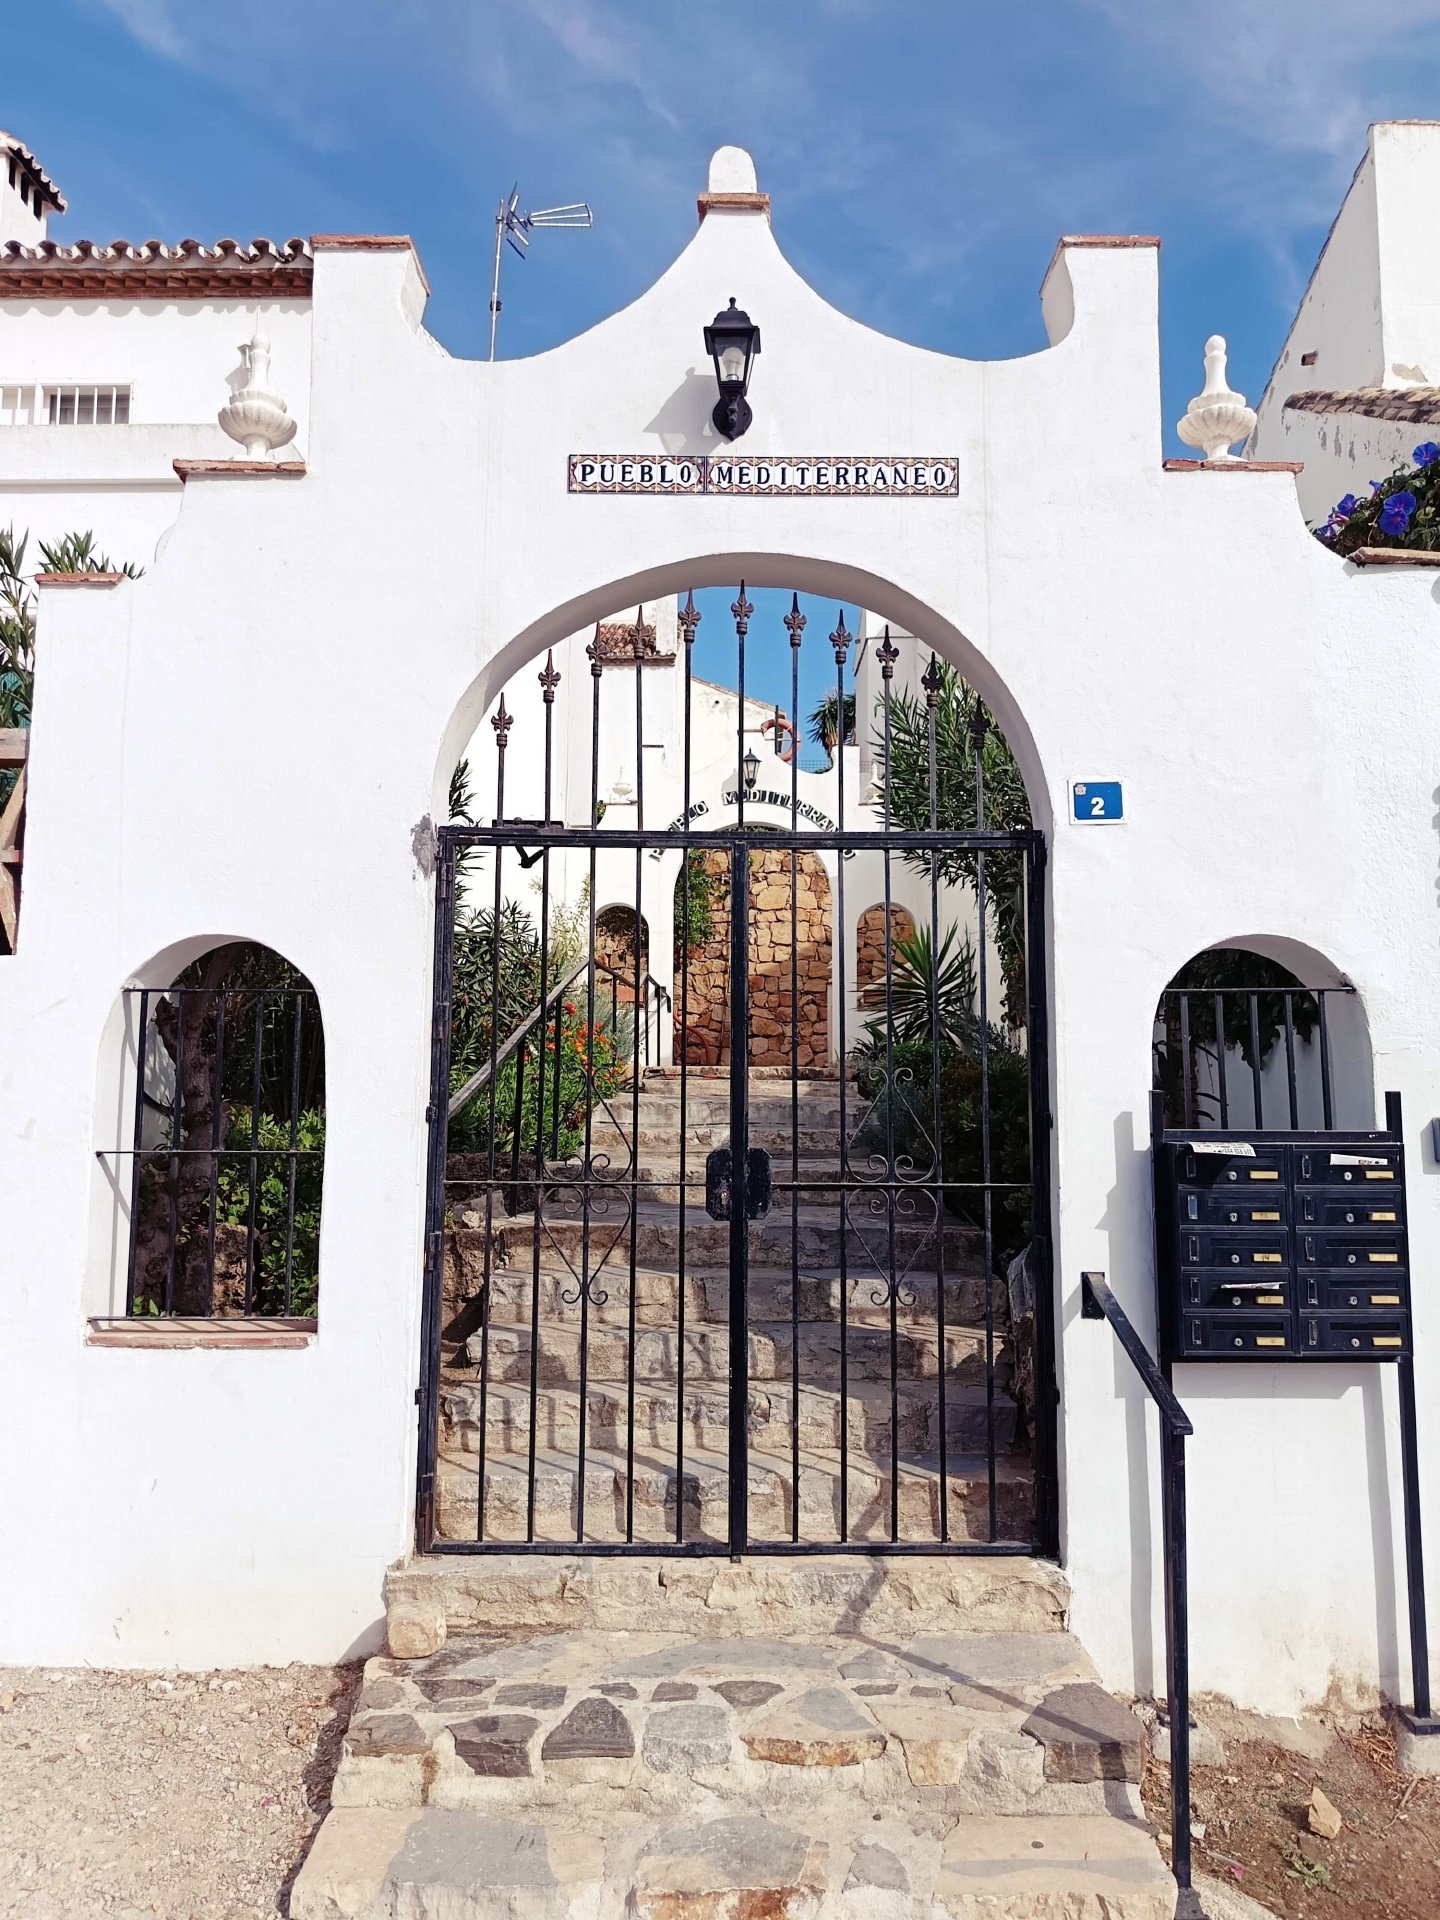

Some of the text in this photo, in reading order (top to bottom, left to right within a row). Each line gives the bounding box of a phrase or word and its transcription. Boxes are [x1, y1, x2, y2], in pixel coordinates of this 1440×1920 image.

[580, 464, 946, 486] PUEBLO MEDITERRANEO
[1090, 796, 1105, 816] 2
[649, 801, 708, 862] PBLO
